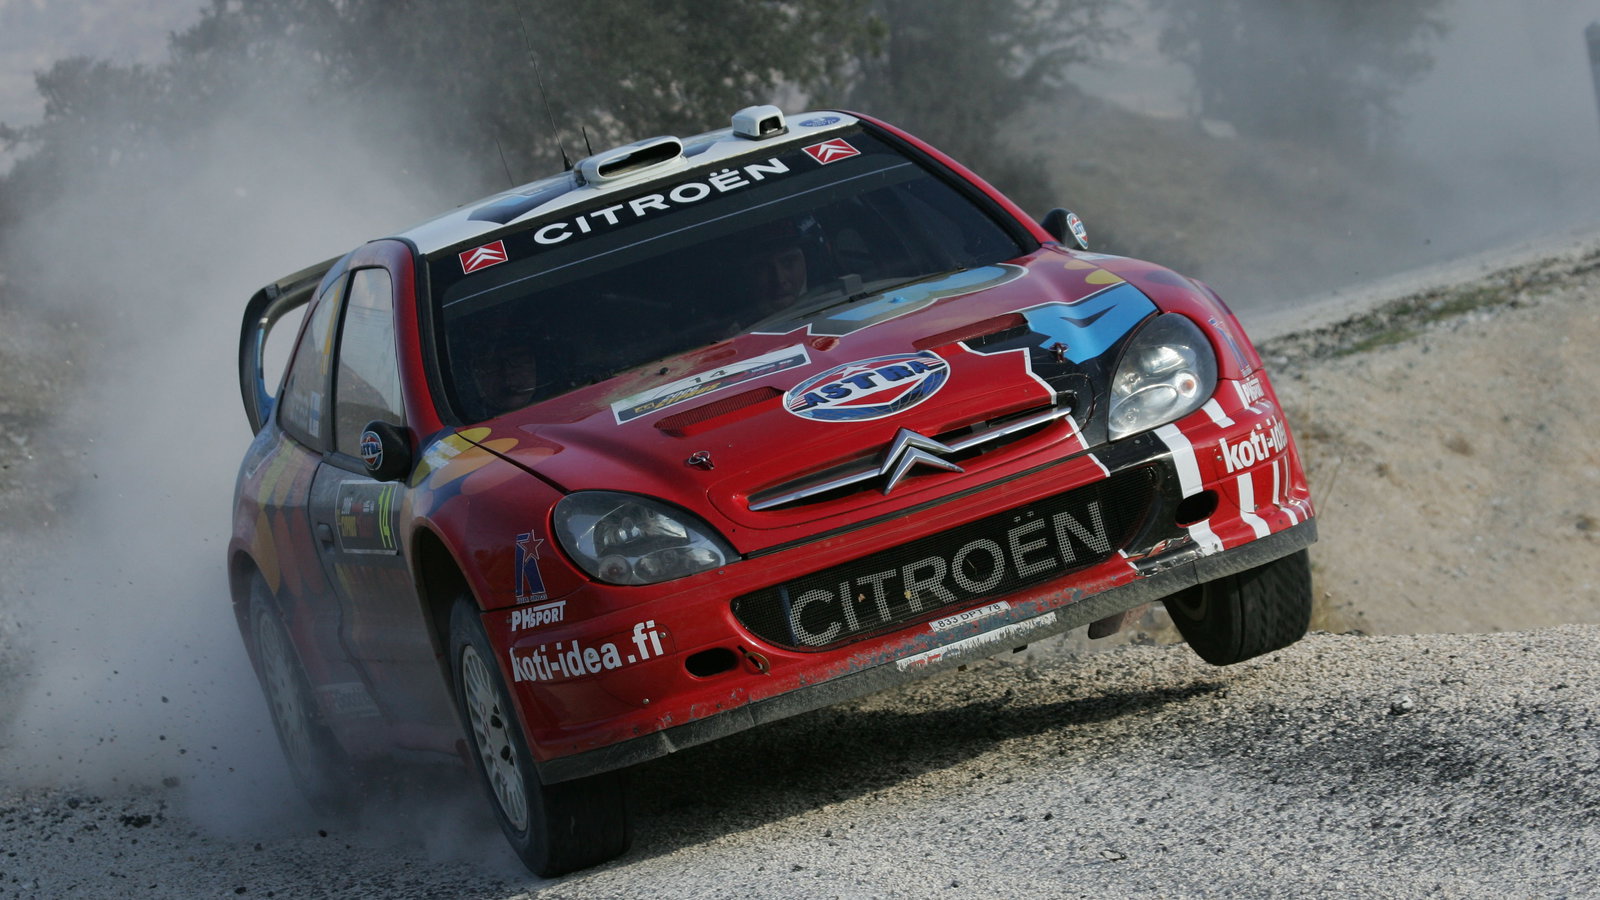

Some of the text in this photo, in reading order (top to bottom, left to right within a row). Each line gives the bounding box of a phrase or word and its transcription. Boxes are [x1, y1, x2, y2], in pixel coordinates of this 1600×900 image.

[533, 157, 790, 245] CITROËN
[689, 369, 728, 384] 14
[803, 360, 932, 408] ASTRA
[789, 501, 1111, 647] CITROËN
[511, 600, 567, 631] PHSPORT
[937, 604, 1001, 628] 833 DPT 78
